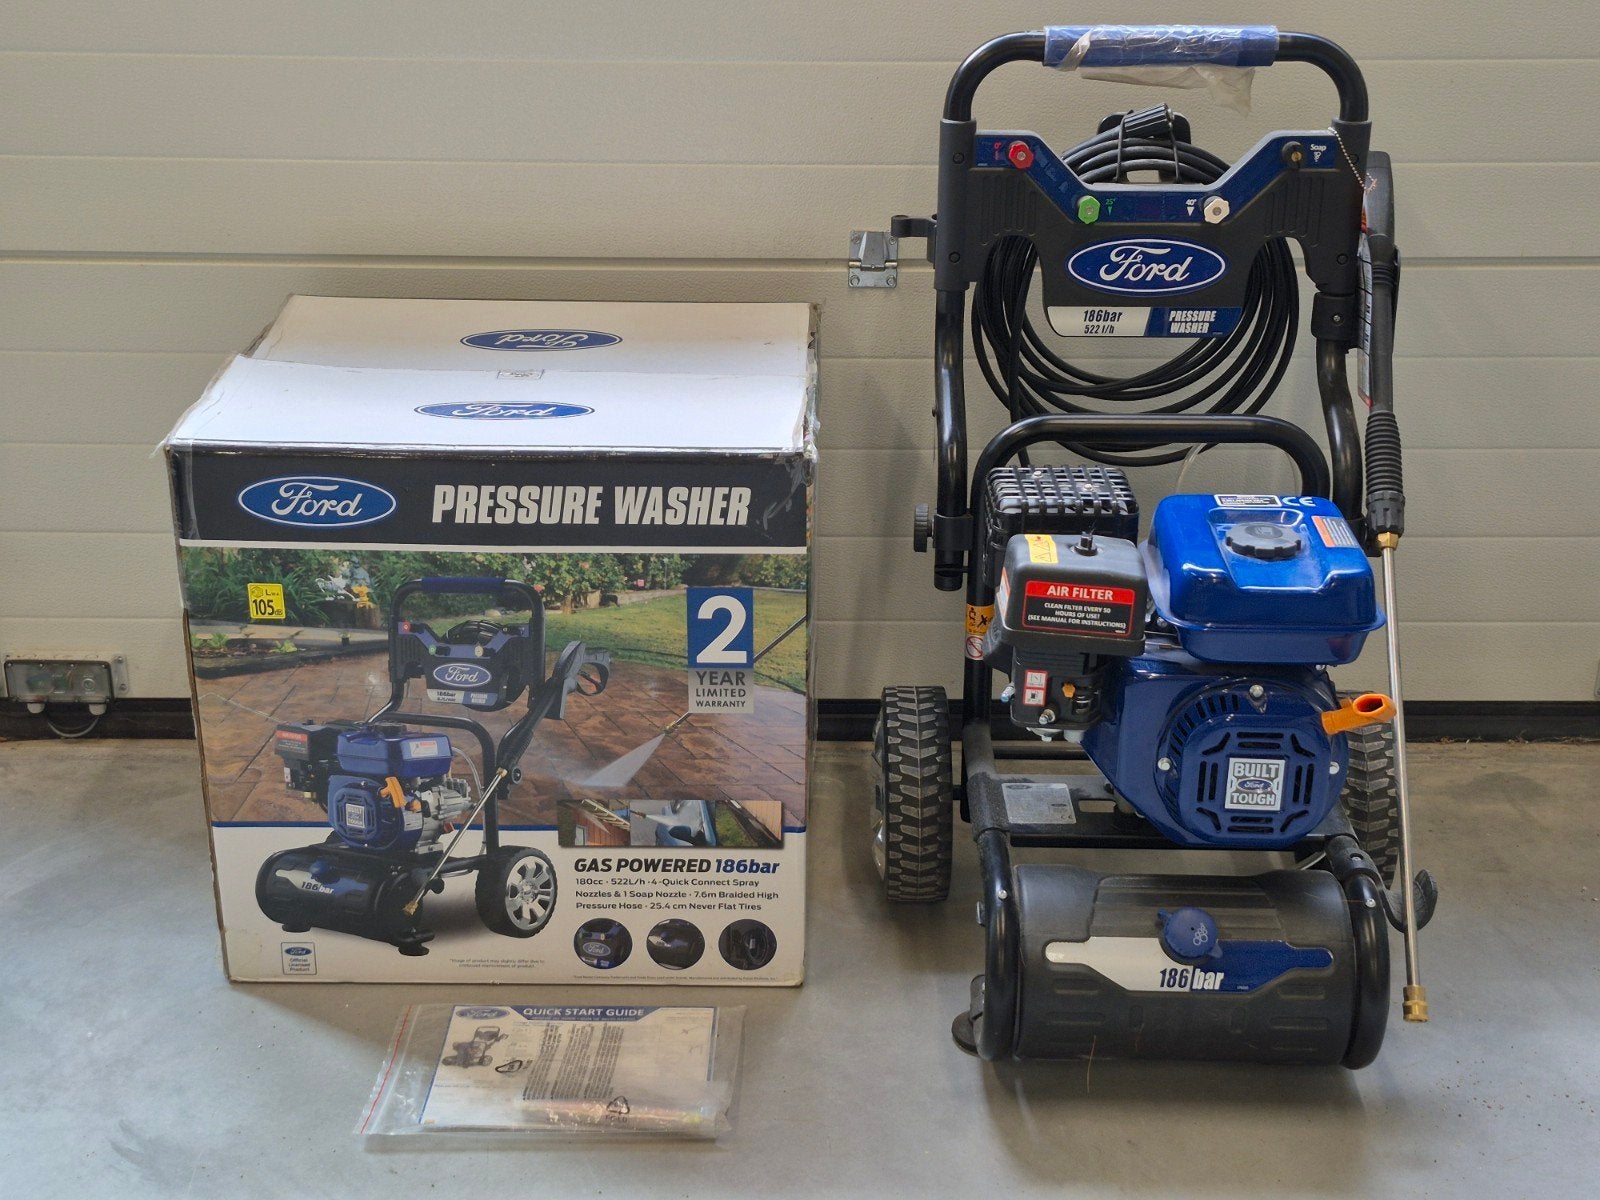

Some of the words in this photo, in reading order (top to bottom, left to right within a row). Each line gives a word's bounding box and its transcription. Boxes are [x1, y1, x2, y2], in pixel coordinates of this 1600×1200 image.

[1310, 144, 1327, 152] Soap
[1100, 245, 1193, 282] Ford
[1083, 309, 1122, 322] 186bar
[1169, 310, 1217, 322] PRESSURE
[1084, 324, 1100, 334] 522
[1170, 322, 1210, 334] WASHER
[495, 334, 589, 348] Ford
[451, 402, 556, 417] Ford
[271, 482, 363, 517] Ford
[432, 484, 603, 525] PRESSURE
[614, 486, 752, 526] WASHER
[1281, 496, 1316, 507] CE
[1047, 585, 1069, 597] AIR
[1072, 587, 1113, 601] FILTER
[252, 599, 275, 616] 105
[1044, 602, 1063, 610] CLEAN
[1084, 605, 1102, 613] EVERY
[1055, 610, 1076, 618] HOURS
[1041, 615, 1067, 624] MANUAL
[1081, 619, 1126, 630] INSTRUCTIONS)
[697, 595, 747, 664] 2
[445, 665, 479, 683] Ford
[695, 670, 746, 686] YEAR
[695, 688, 747, 698] LIMITED
[695, 700, 746, 708] WARRANTY
[1233, 762, 1280, 778] BUILT
[1231, 792, 1276, 805] TOUGH
[574, 858, 613, 873] GAS
[615, 858, 712, 873] POWERED
[715, 858, 780, 874] 186bar
[576, 878, 604, 886] 180cc
[610, 878, 646, 886] 522L/h
[691, 878, 731, 886] Connect
[732, 879, 760, 888] Spray
[575, 890, 612, 898] Nozzles
[613, 890, 621, 898] &
[623, 890, 627, 898] 1
[629, 890, 654, 899] Soap
[718, 891, 755, 899] Braided
[757, 892, 779, 900] High
[576, 902, 617, 910] Pressure
[619, 902, 643, 910] Hose
[650, 902, 671, 910] 25.4
[718, 903, 737, 911] Flat
[739, 903, 762, 911] Tires
[465, 1009, 498, 1019] Ford
[523, 1007, 562, 1017] QUICK
[564, 1008, 603, 1017] START
[605, 1008, 645, 1017] GUIDE
